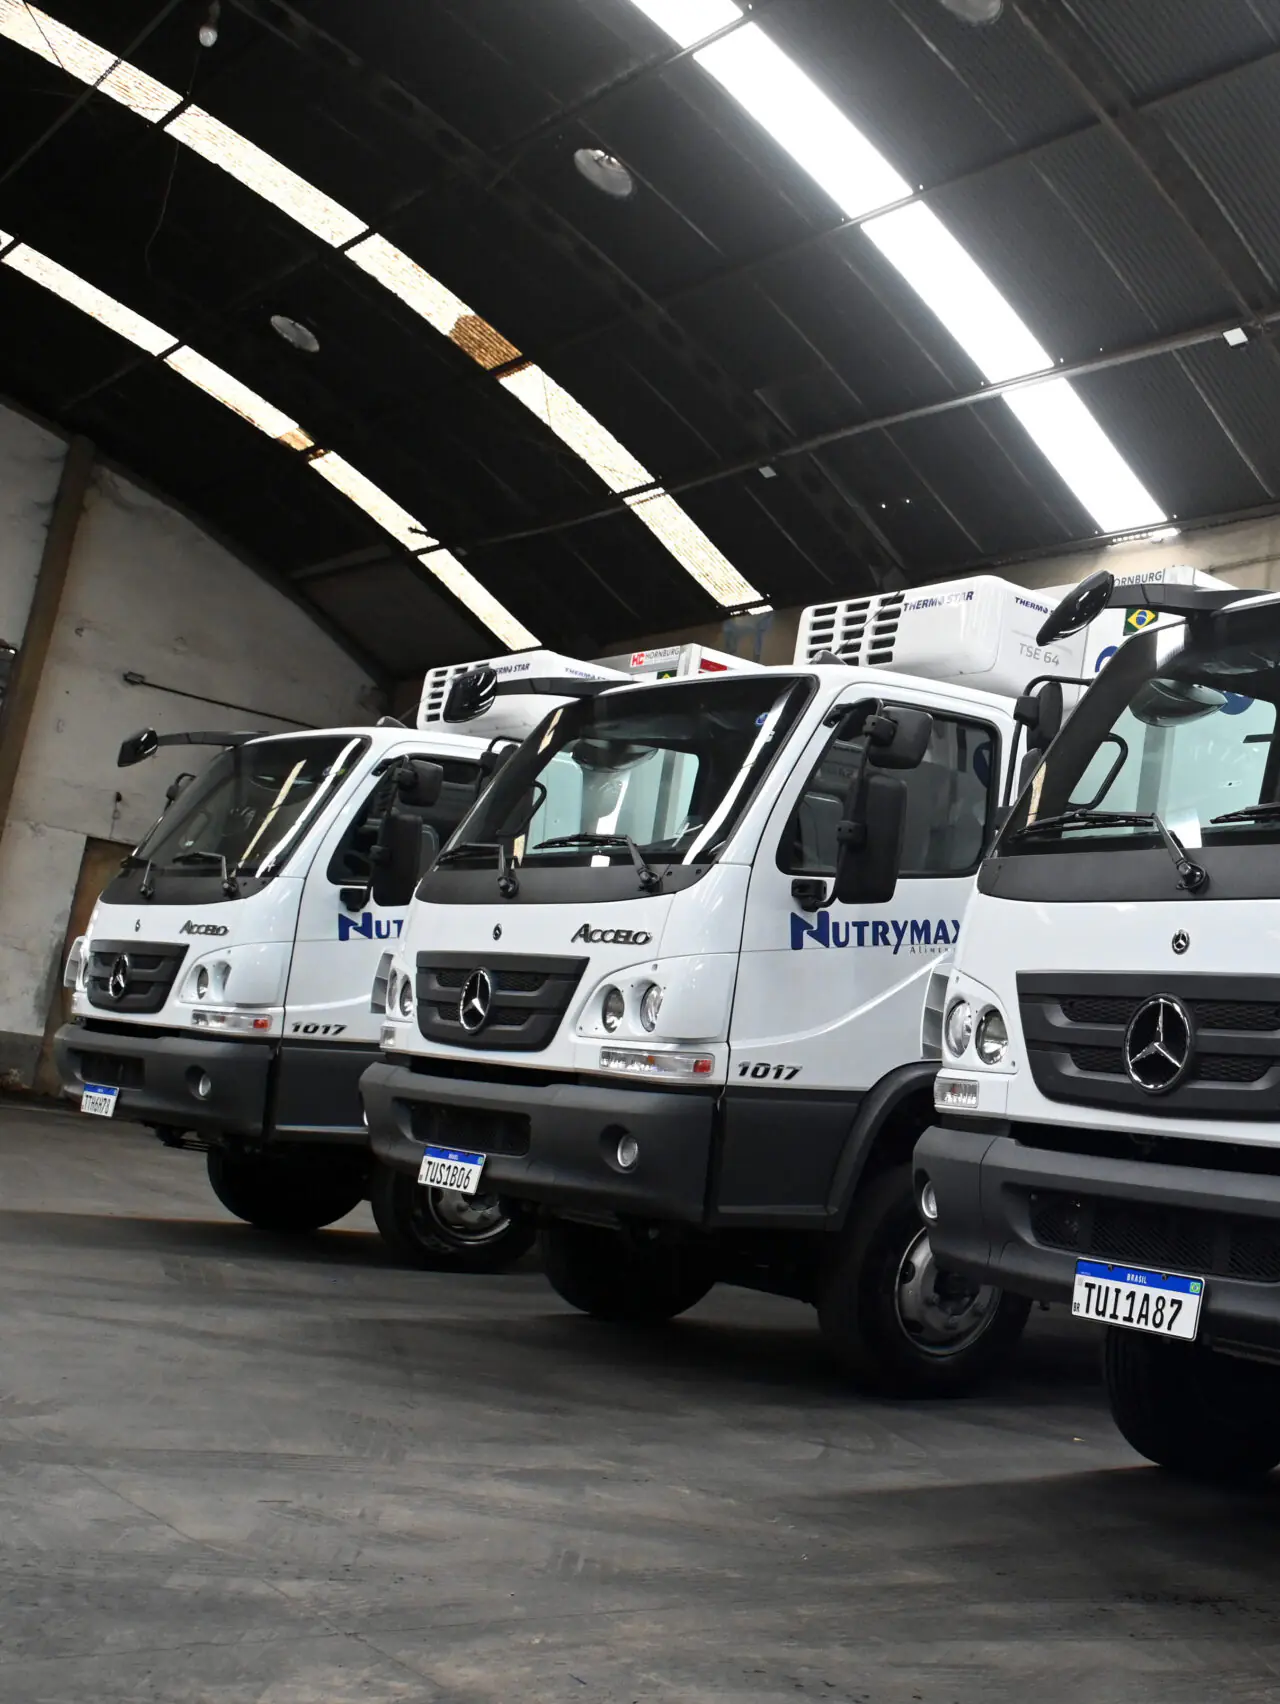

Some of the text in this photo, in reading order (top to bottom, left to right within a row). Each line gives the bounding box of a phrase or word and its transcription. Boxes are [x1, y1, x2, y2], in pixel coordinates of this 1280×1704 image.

[1015, 597, 1048, 614] THERMO
[1020, 643, 1060, 667] TSE 64
[291, 1021, 348, 1036] 1017
[738, 1061, 803, 1081] 1017
[425, 1160, 473, 1190] TUS1B06
[1126, 1273, 1147, 1285] BRASIL
[1084, 1281, 1183, 1331] TUI1A87
